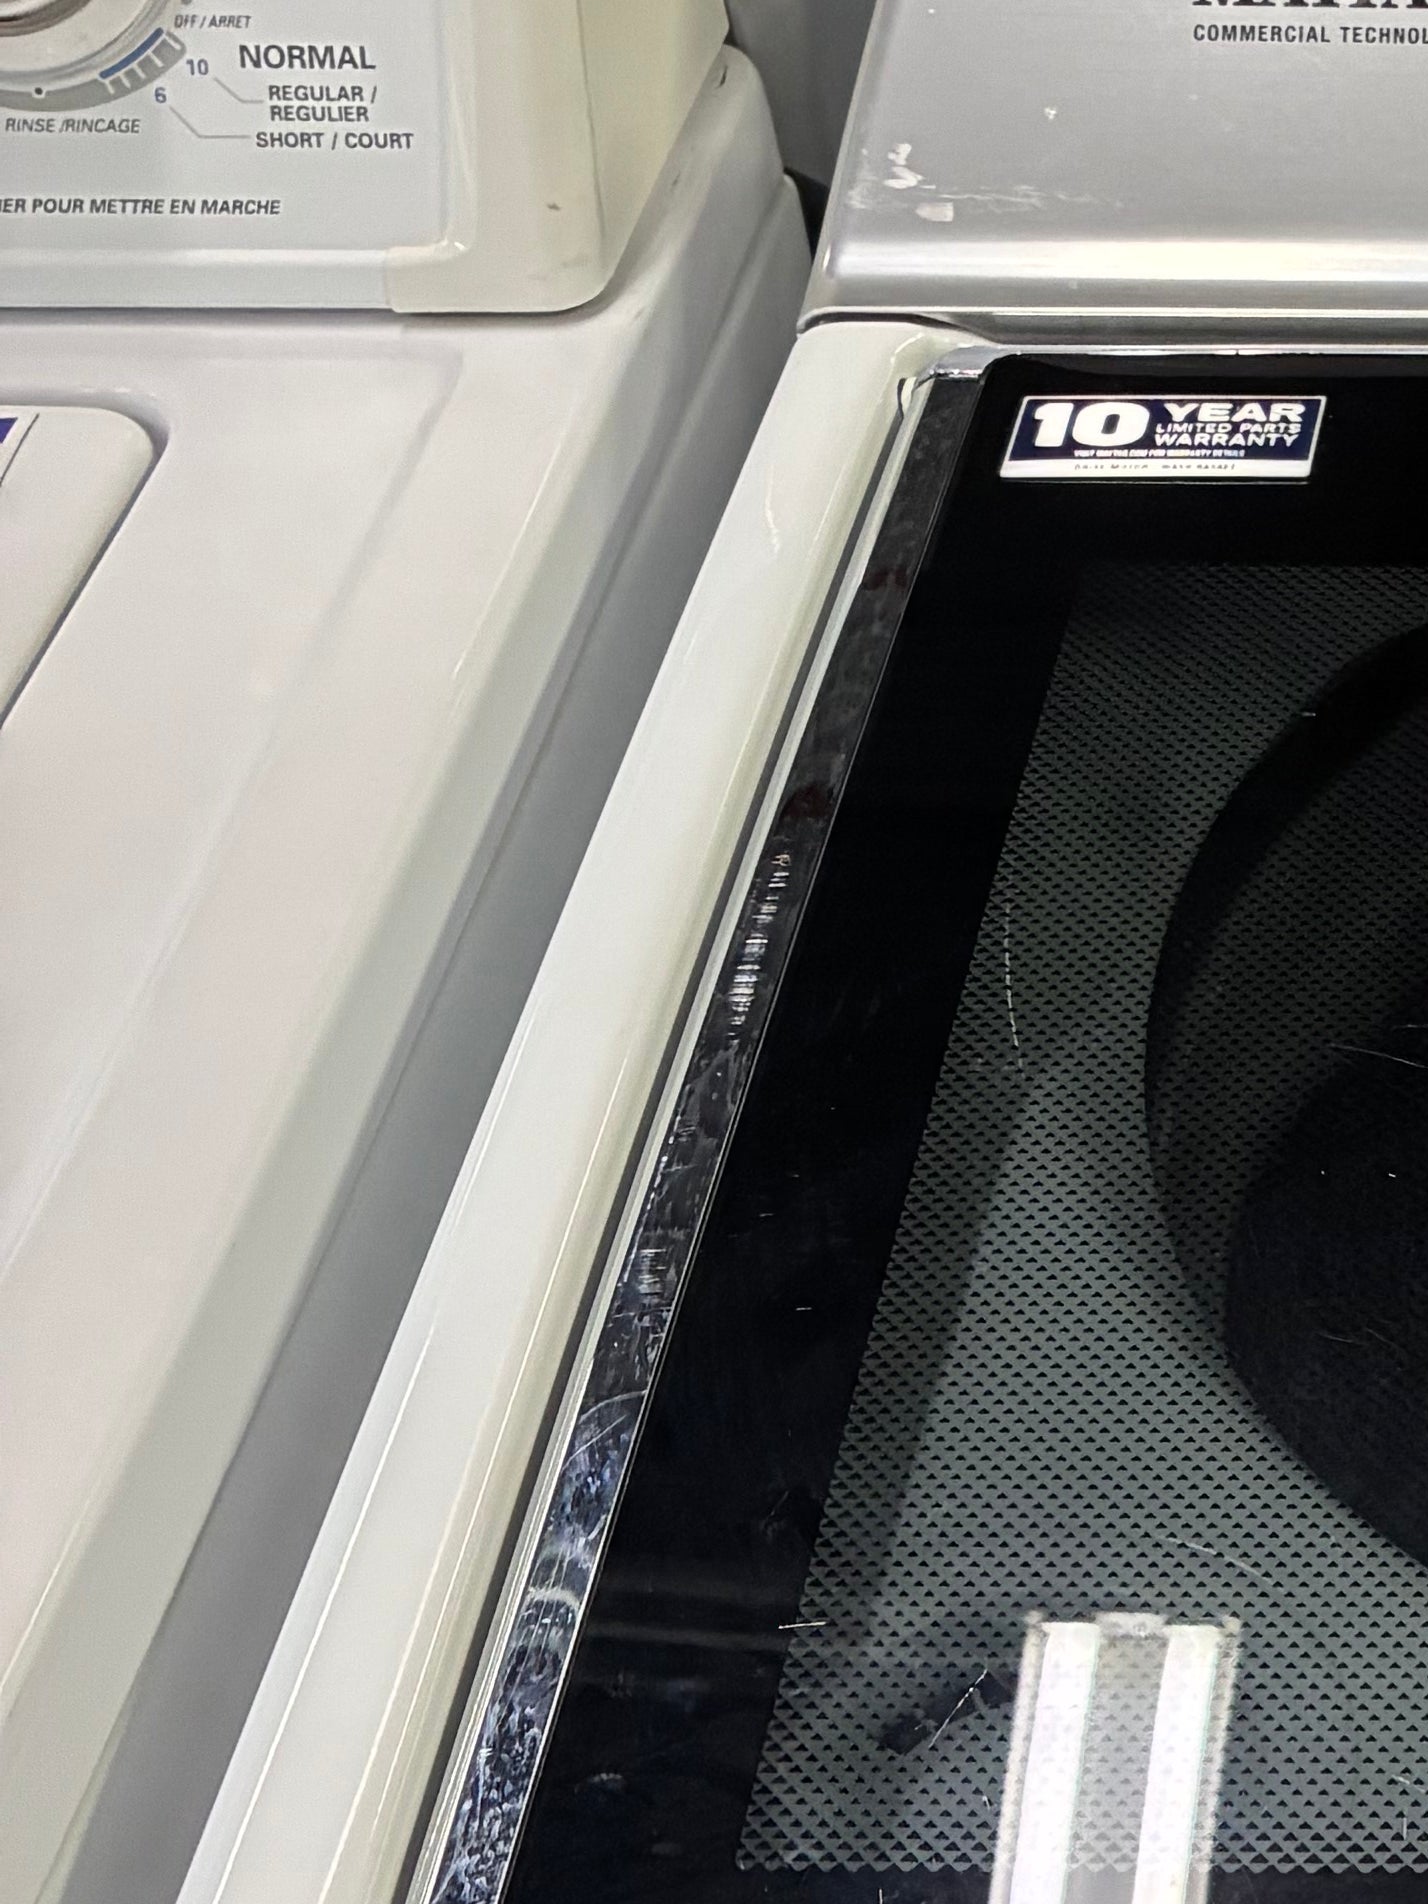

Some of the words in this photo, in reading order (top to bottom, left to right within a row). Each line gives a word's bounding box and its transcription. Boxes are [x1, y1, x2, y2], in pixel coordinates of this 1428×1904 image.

[174, 14, 199, 30] OFF
[209, 14, 252, 29] ARRET
[1192, 24, 1331, 45] COMMERCIAL
[239, 43, 377, 71] NORMAL
[186, 58, 209, 76] 10
[268, 84, 365, 102] REGULAR
[154, 86, 167, 104] 6
[256, 132, 324, 149] SHORT
[345, 132, 414, 150] COURT
[270, 105, 370, 123] REGULIER
[5, 118, 57, 134] RINSE
[32, 198, 85, 215] POUR
[90, 198, 165, 215] METTRE
[170, 199, 196, 215] EN
[200, 199, 281, 216] MARCHE
[1033, 401, 1151, 448] 10
[1163, 402, 1306, 423] YEAR
[1155, 422, 1232, 434] LIMITED
[1239, 422, 1302, 435] PARTS
[1154, 433, 1300, 447] WARRANTY
